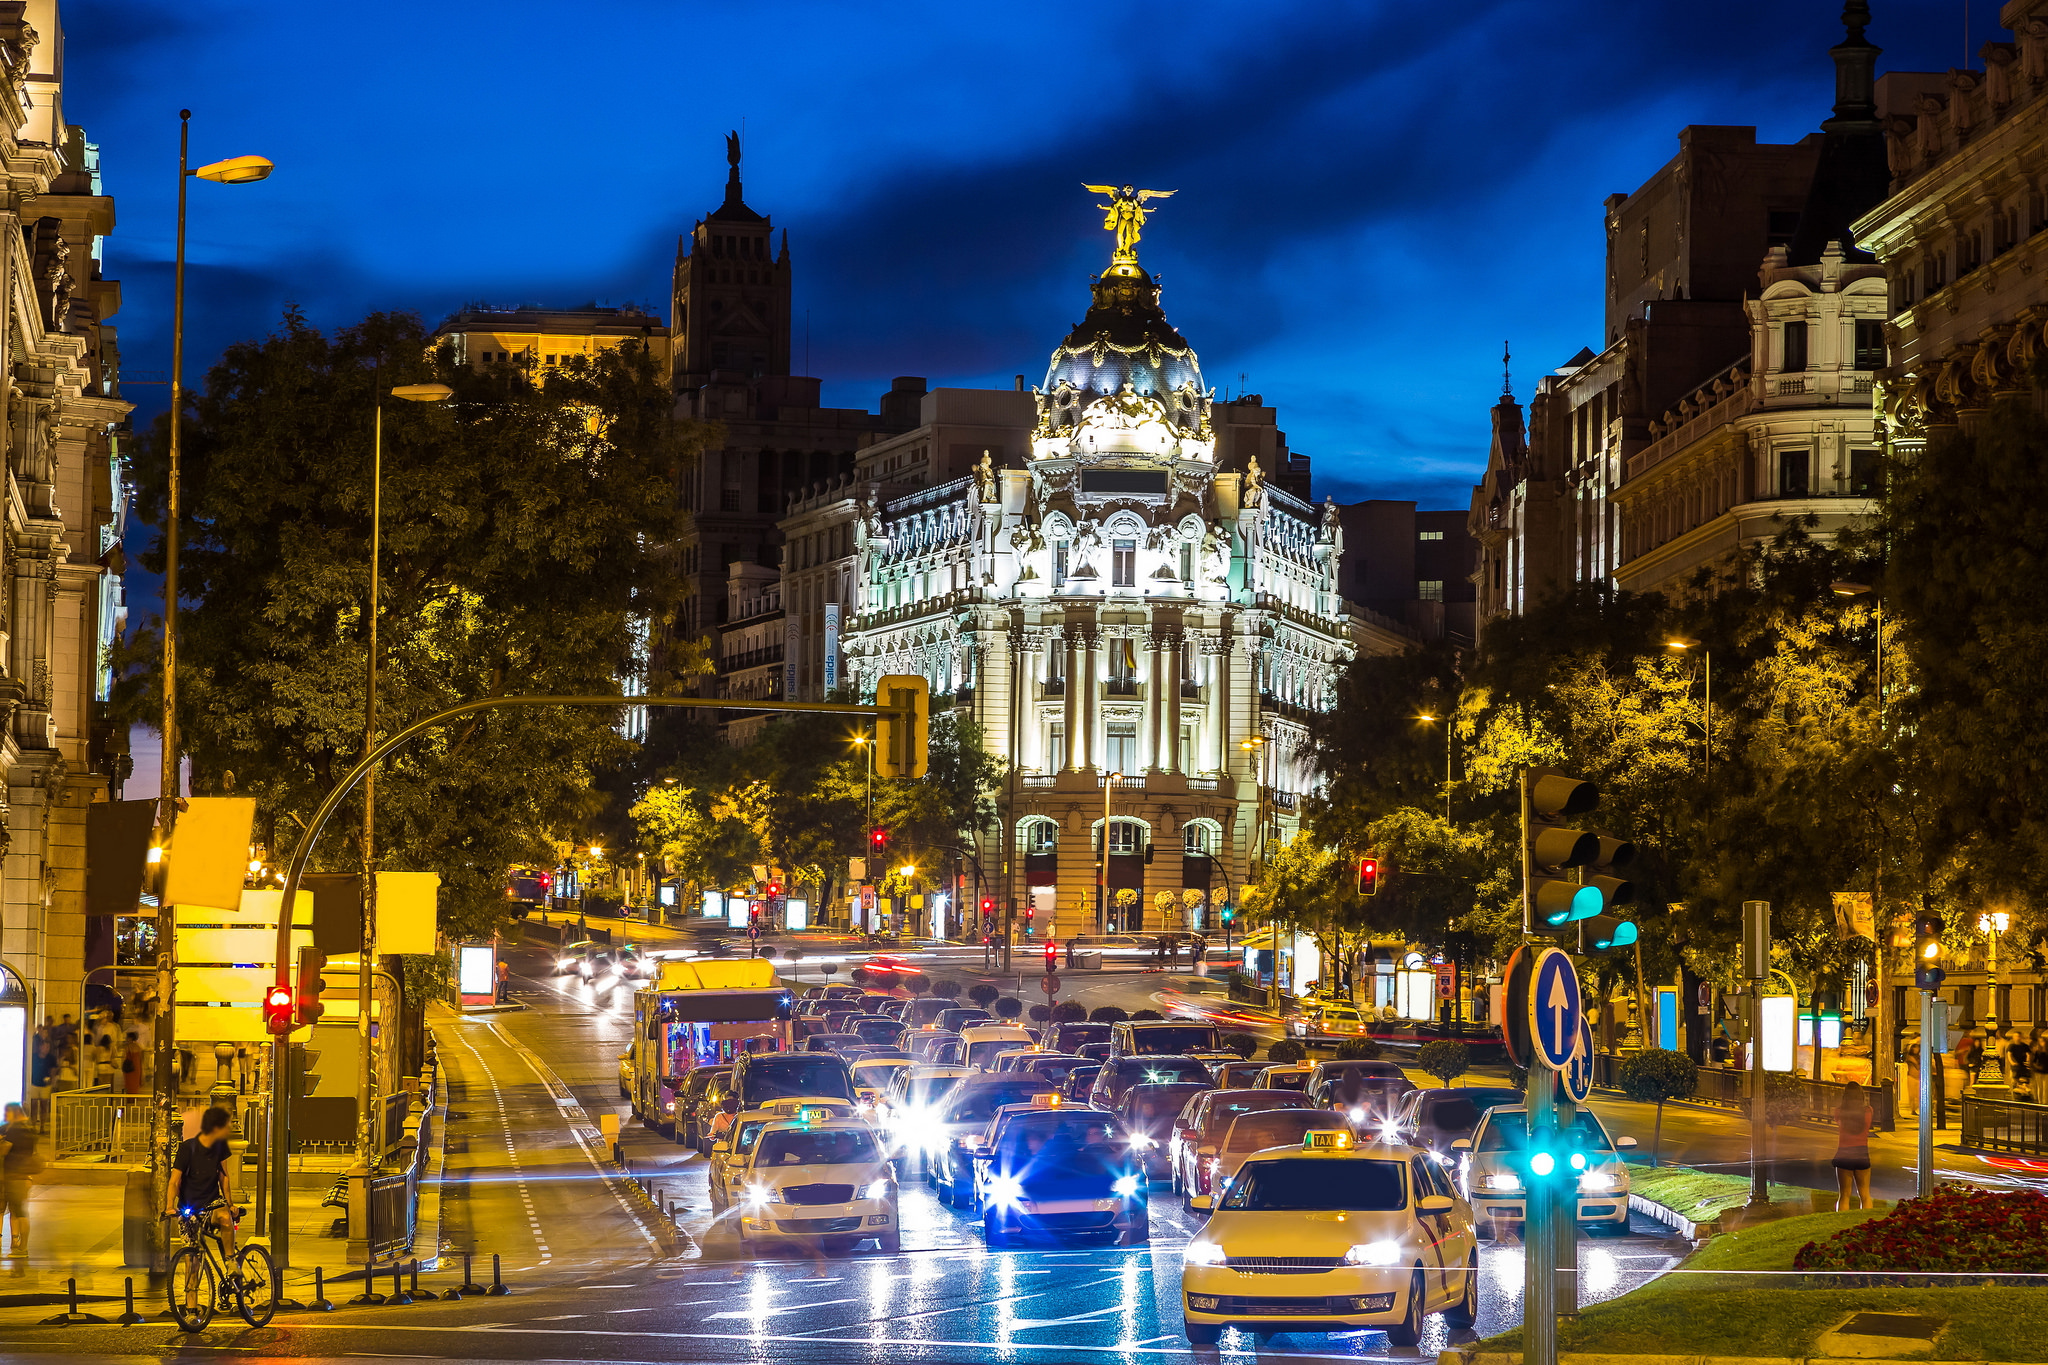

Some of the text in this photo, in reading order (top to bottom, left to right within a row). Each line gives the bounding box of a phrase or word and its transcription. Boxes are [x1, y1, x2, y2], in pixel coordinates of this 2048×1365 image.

[826, 655, 834, 686] salida
[786, 664, 796, 692] salida
[1052, 1096, 1058, 1104] 2
[794, 1104, 800, 1113] 2
[1314, 1133, 1346, 1147] TAXI 2
